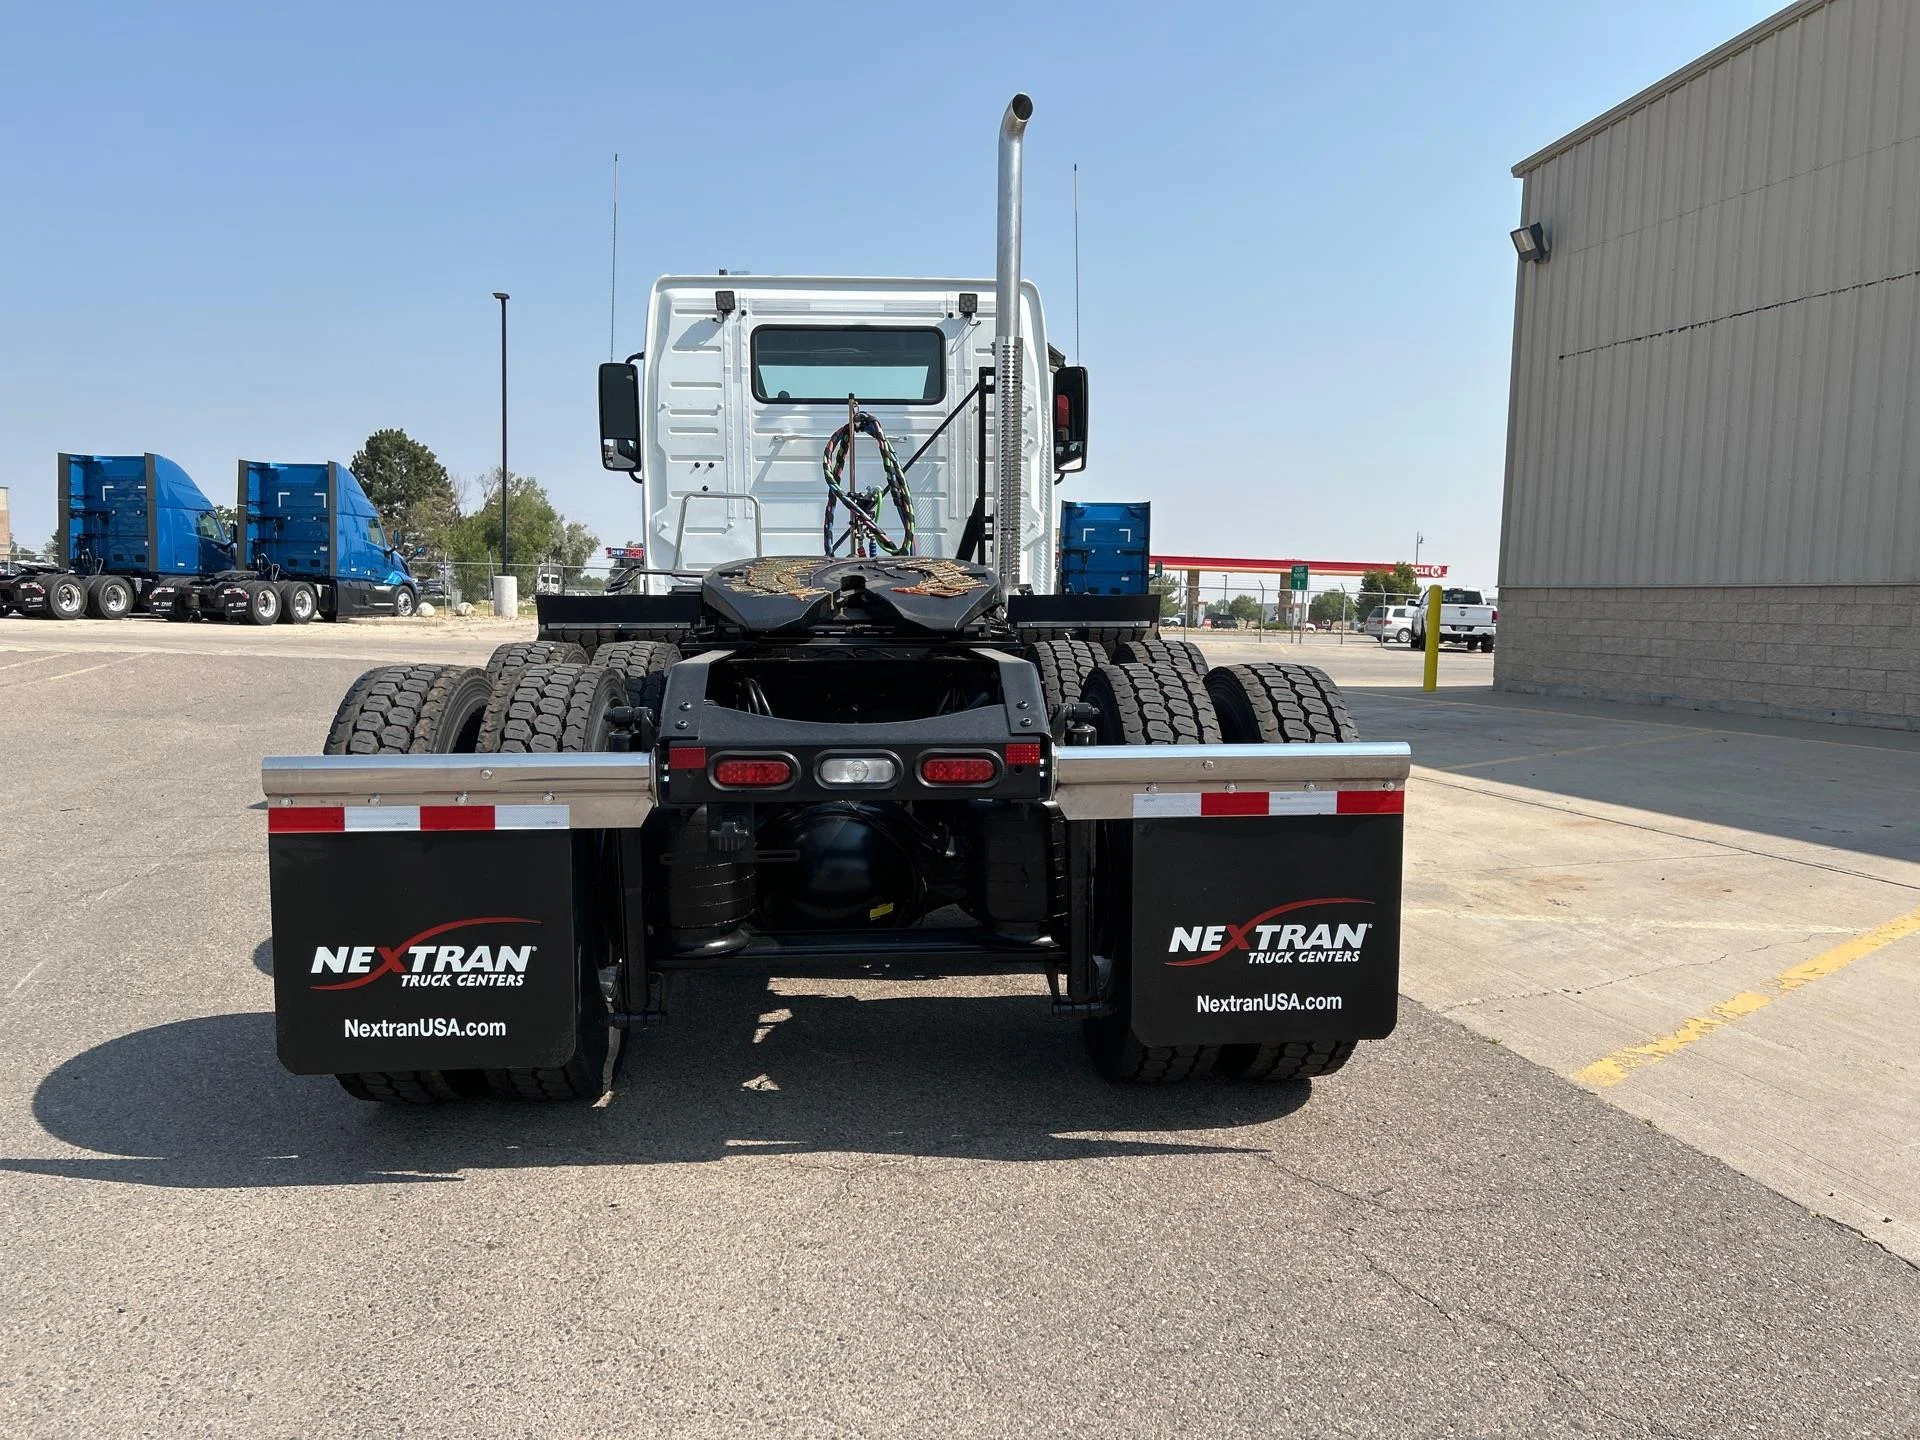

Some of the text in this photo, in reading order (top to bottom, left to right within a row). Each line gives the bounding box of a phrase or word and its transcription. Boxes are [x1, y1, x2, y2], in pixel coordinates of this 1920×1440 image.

[1168, 923, 1368, 953] NEXTRAN
[310, 945, 532, 974] NEXTRAN
[1248, 950, 1361, 964] TRUCK CENTERS
[401, 974, 525, 987] TRUCK CENTERS
[1196, 992, 1343, 1013] NextranUSA.com
[344, 1017, 507, 1038] NextranUSA.com
